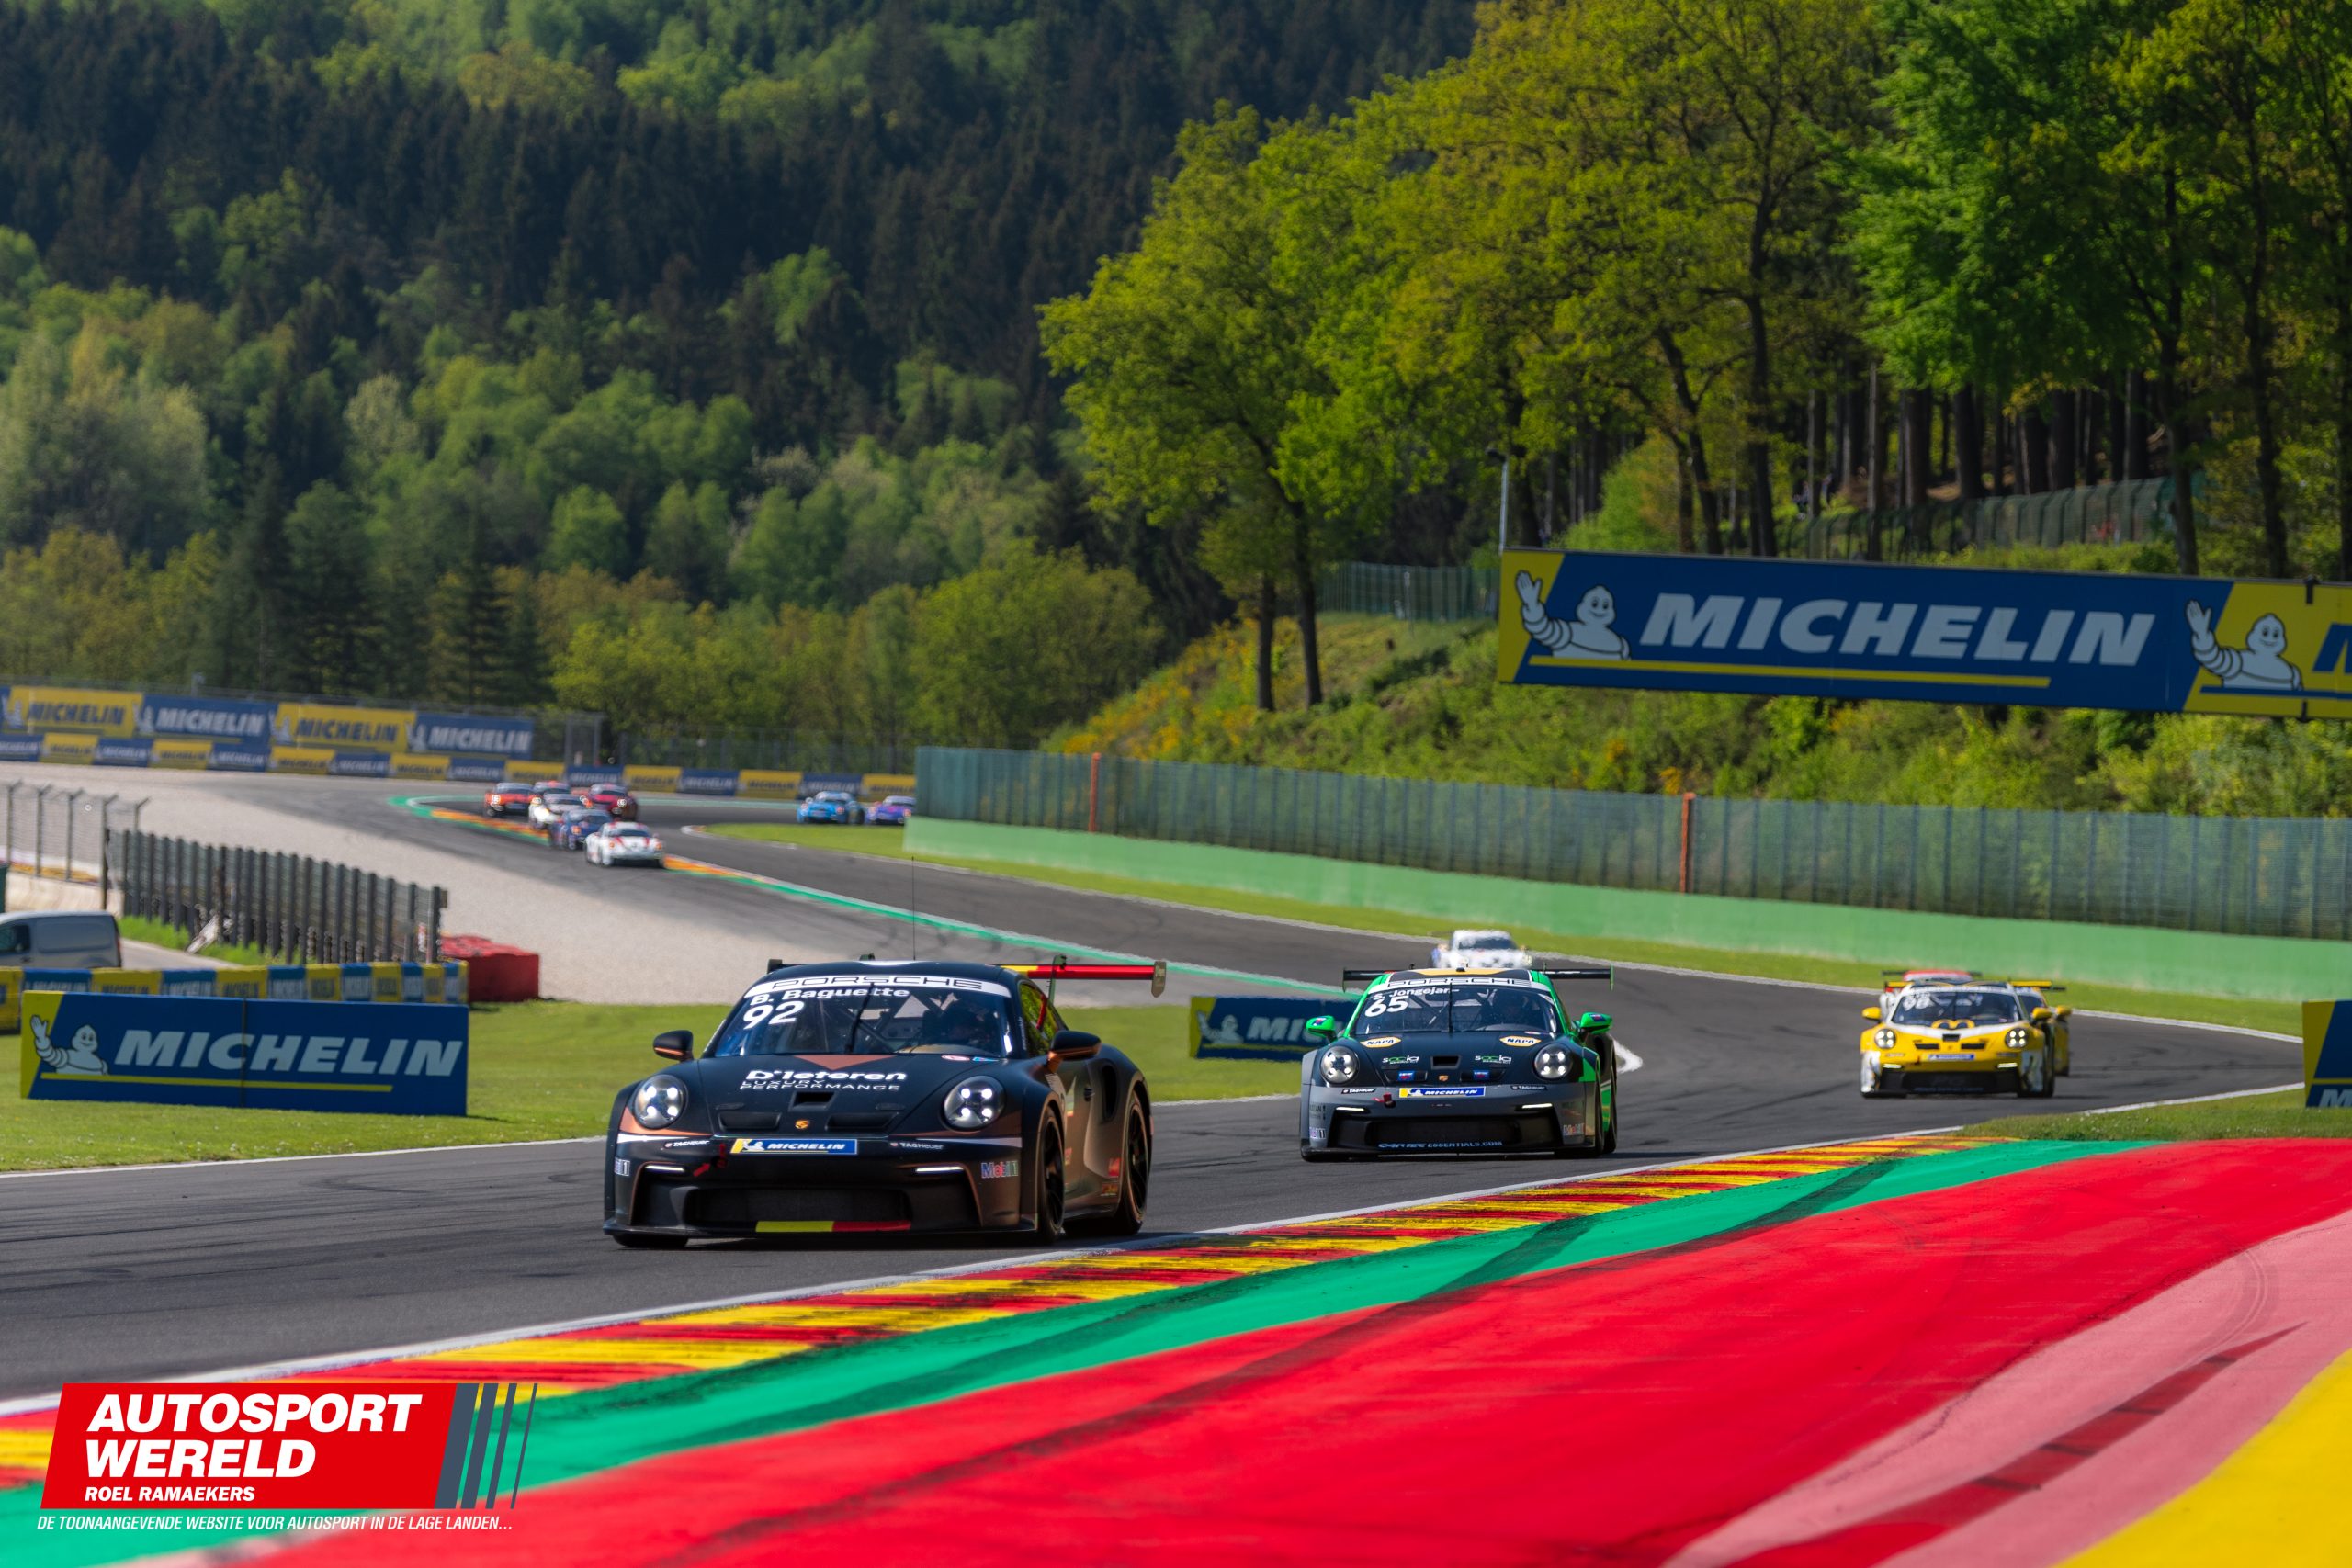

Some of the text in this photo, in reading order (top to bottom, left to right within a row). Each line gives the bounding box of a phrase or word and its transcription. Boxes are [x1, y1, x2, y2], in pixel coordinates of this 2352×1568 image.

[1639, 592, 2156, 667] MICHELIN
[27, 700, 127, 726] MICHELIN
[156, 707, 266, 736] MICHELIN
[296, 718, 399, 742] MICHELIN
[429, 726, 532, 754] MICHELIN
[772, 976, 982, 990] PORSCHE
[1388, 977, 1532, 988] PORSCHE
[750, 987, 910, 1007] B. Baguette
[1364, 995, 1409, 1018] 65
[742, 1000, 805, 1031] 92
[114, 1028, 464, 1077] MICHELIN
[739, 1083, 901, 1091] PERFORMANCE
[769, 1142, 847, 1151] MICHELIN
